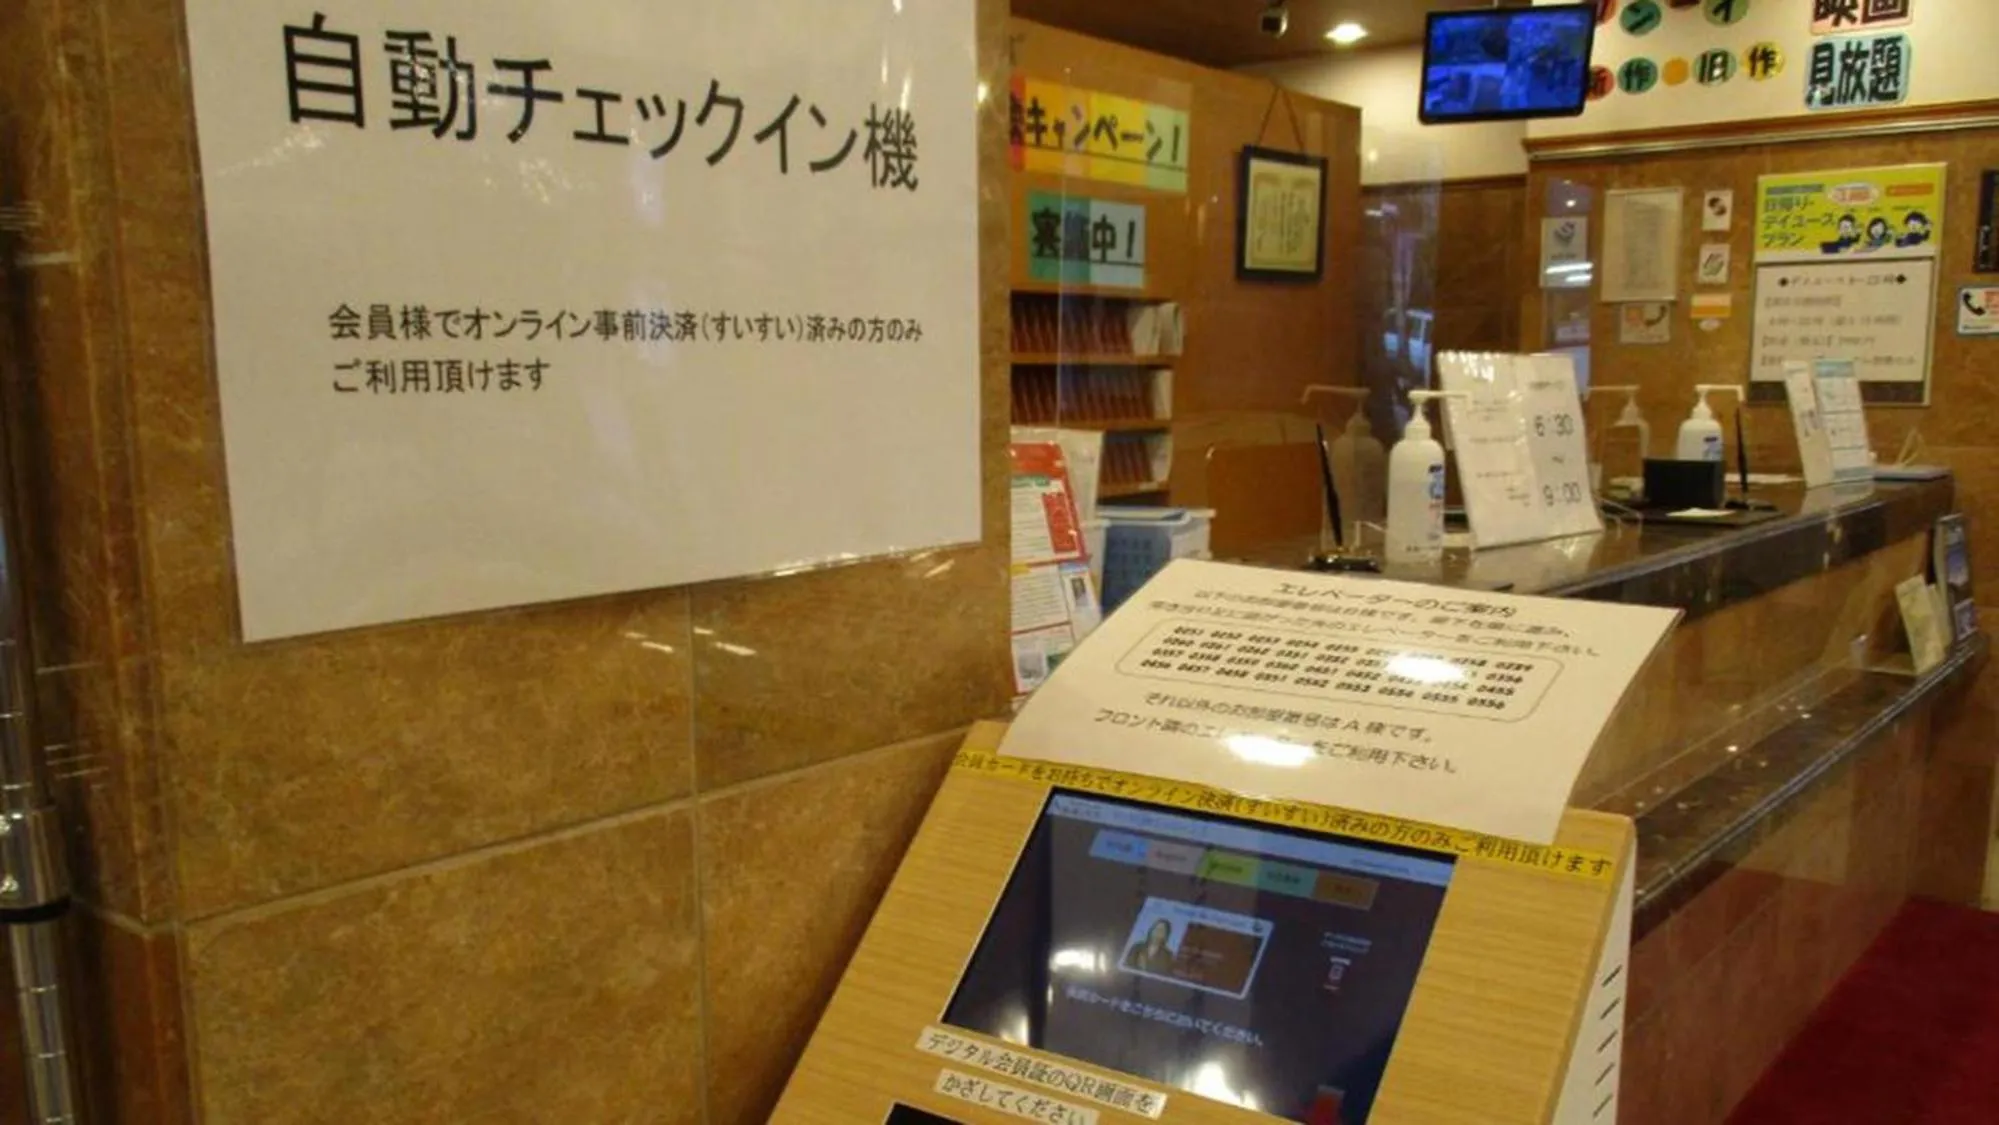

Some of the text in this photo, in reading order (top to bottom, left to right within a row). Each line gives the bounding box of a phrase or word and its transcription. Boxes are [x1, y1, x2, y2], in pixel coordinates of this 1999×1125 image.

[283, 11, 919, 191] 自動チェックイン機
[1805, 35, 1903, 105] 見放題
[332, 358, 551, 395] ご利用頂けます
[1273, 582, 1517, 618] エレベーターのご案内
[927, 1032, 1154, 1113] デジタル会員証のQR画面を
